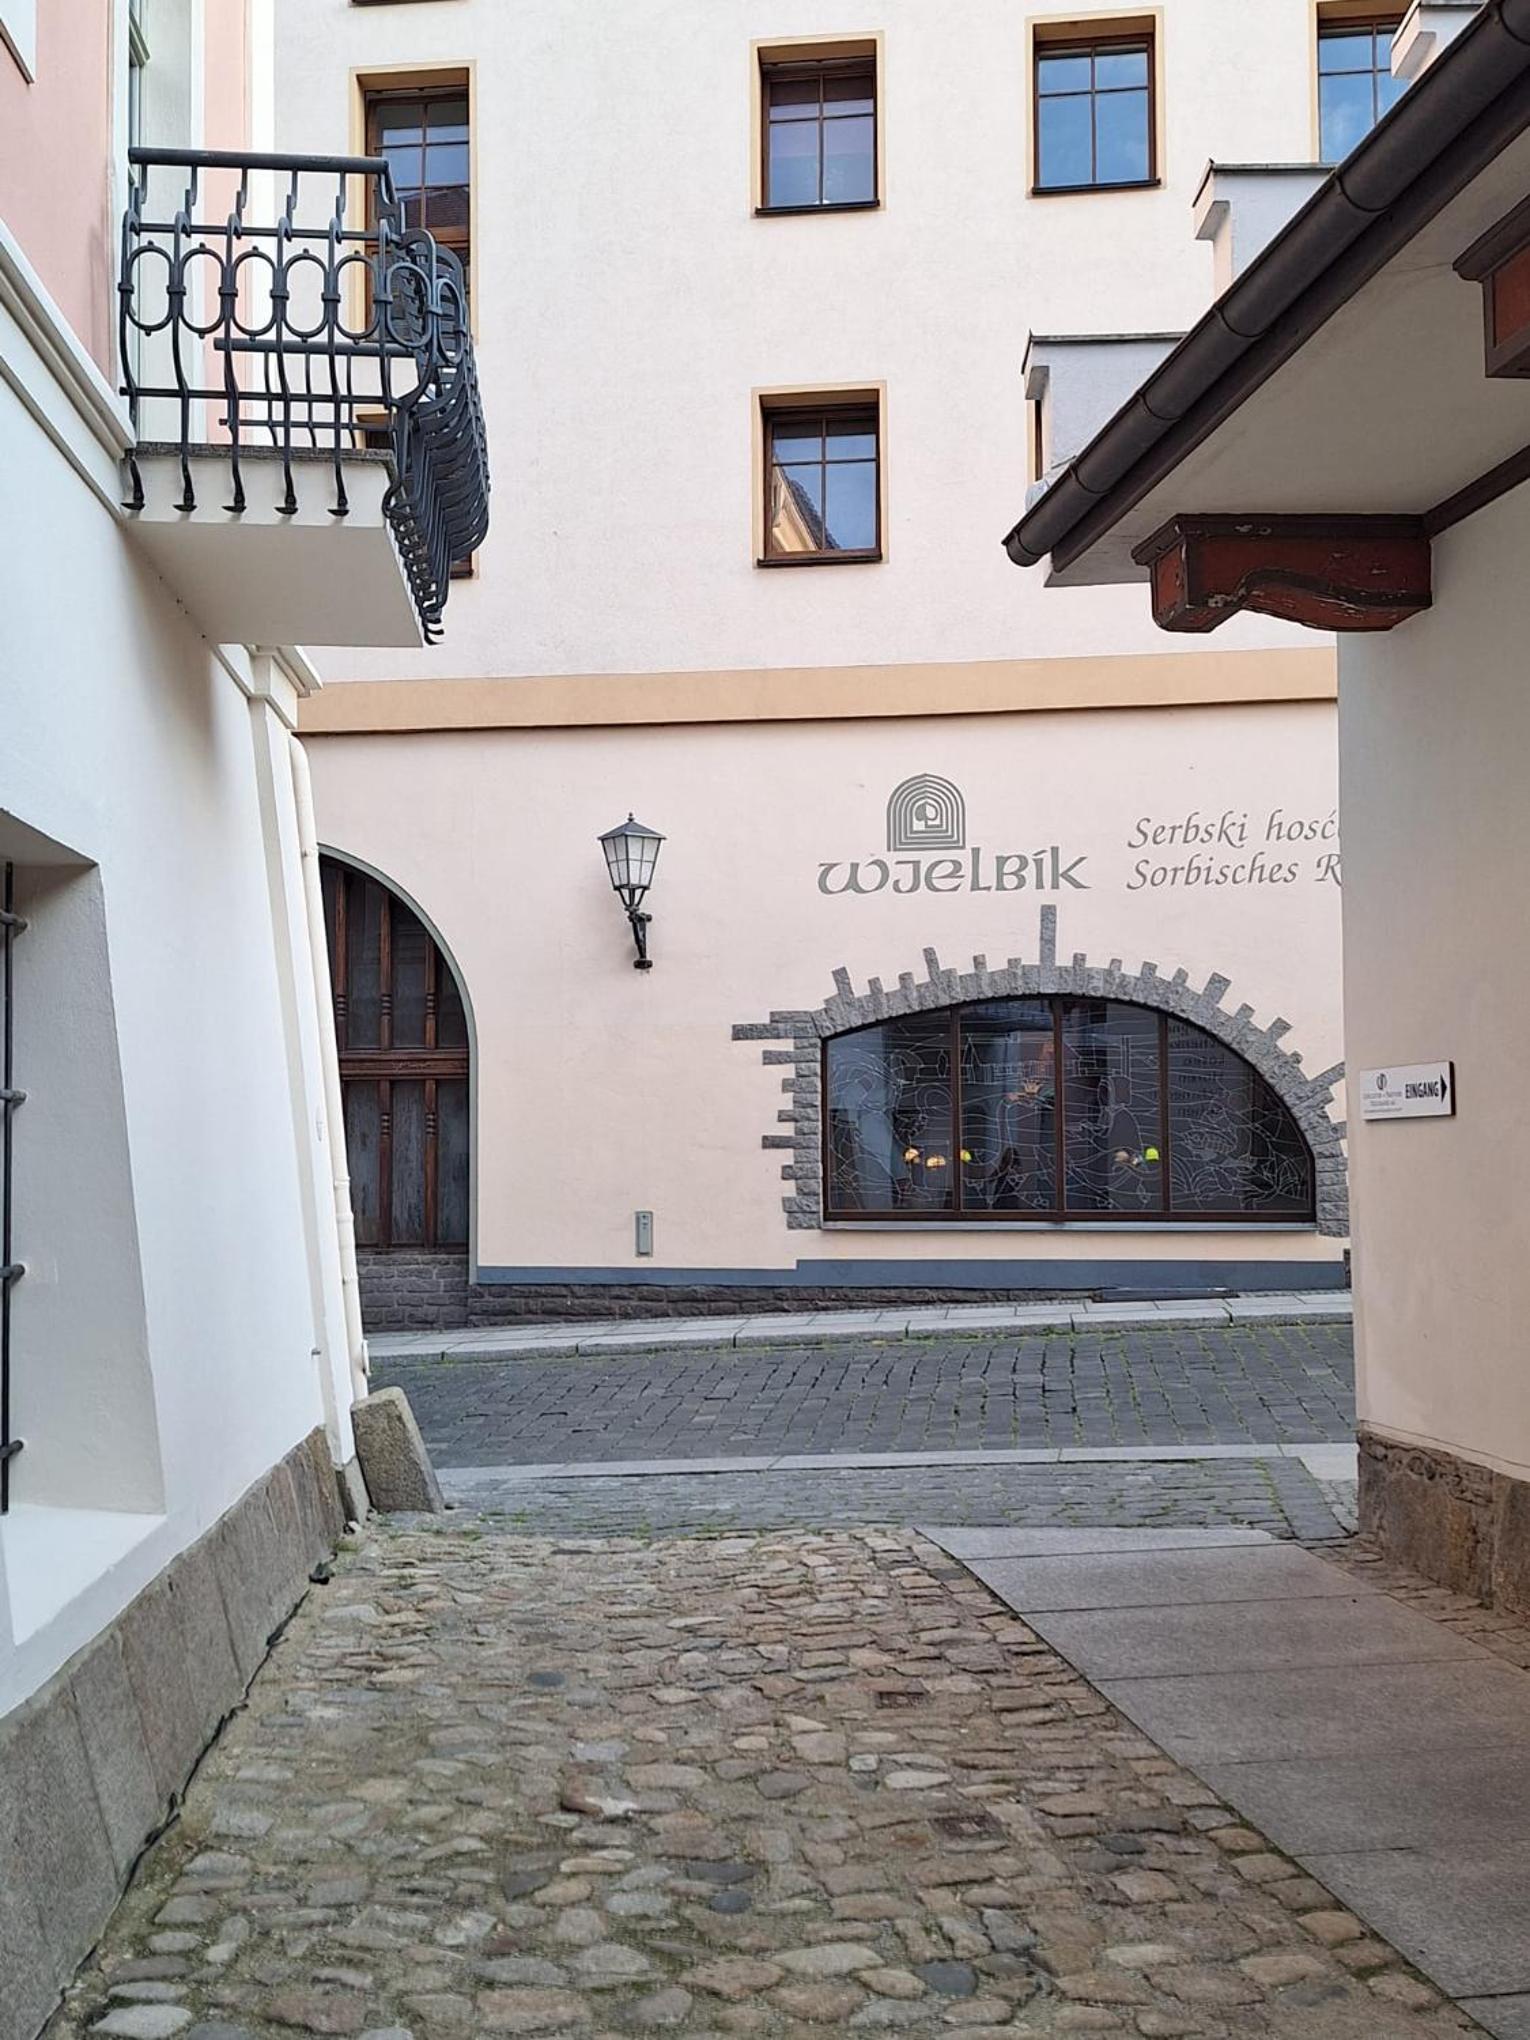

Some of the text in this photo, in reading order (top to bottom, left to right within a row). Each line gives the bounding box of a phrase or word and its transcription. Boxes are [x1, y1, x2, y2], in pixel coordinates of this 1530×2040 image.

[1127, 809, 1340, 848] Serbski hosć
[1126, 852, 1299, 890] Sorbisches
[1404, 1081, 1440, 1100] EINGANG
